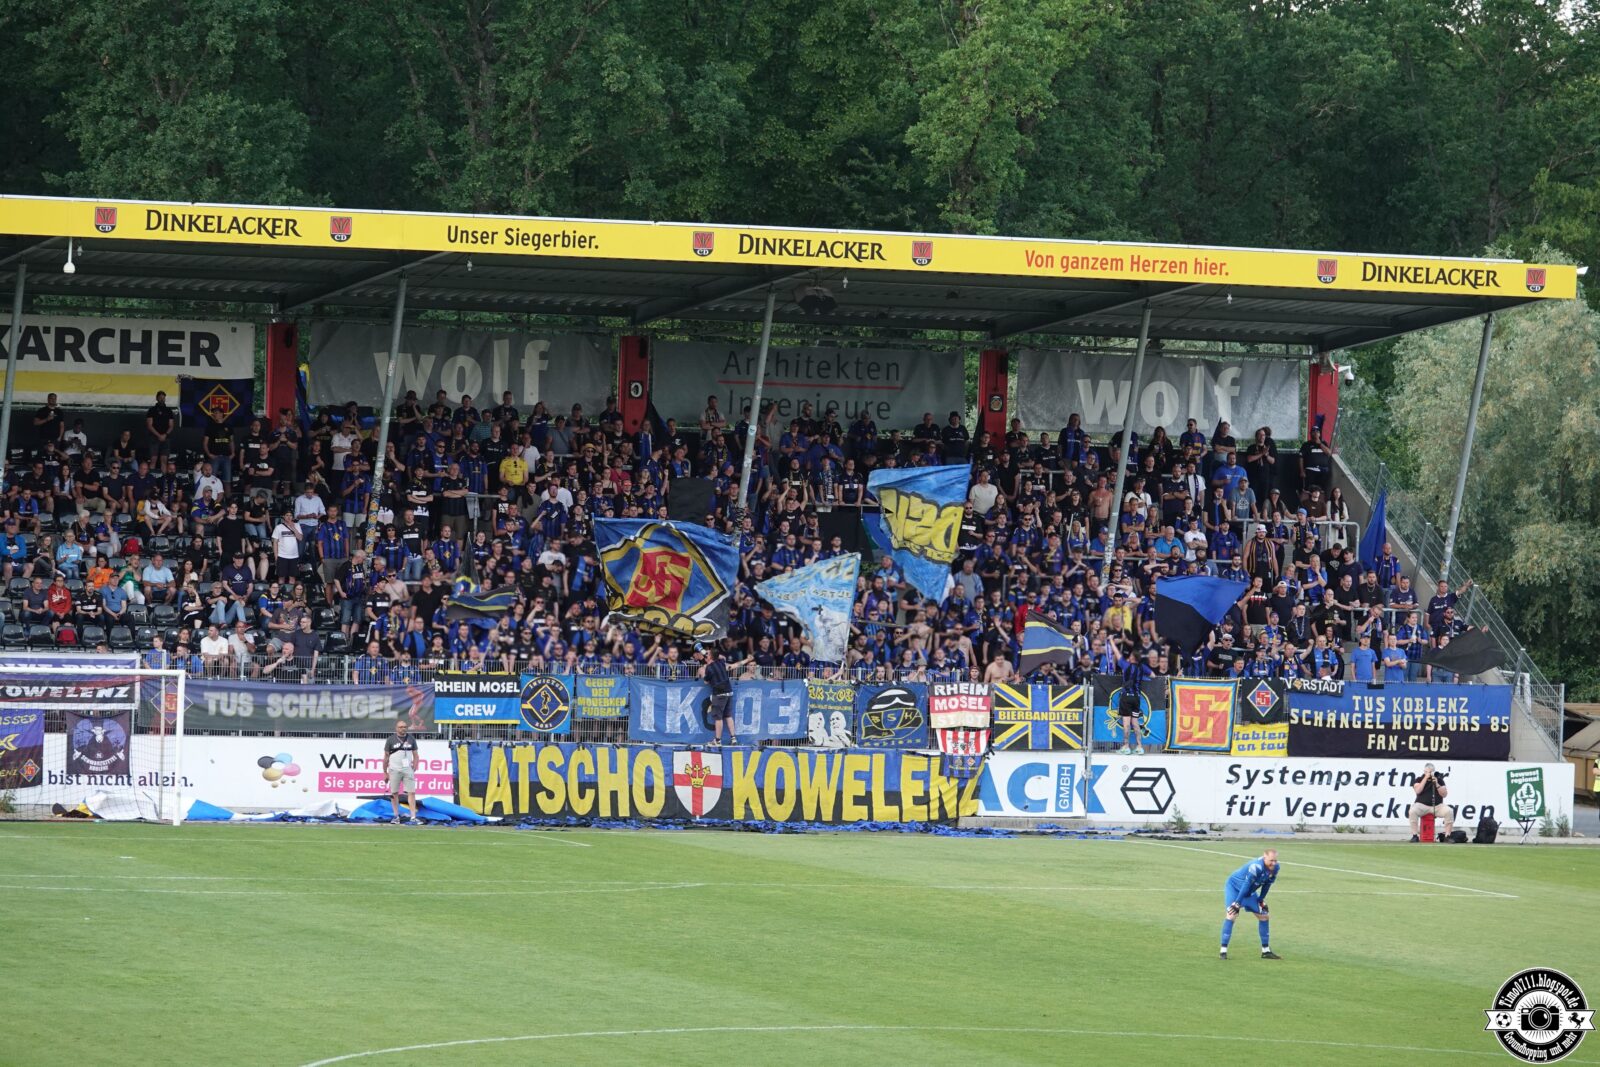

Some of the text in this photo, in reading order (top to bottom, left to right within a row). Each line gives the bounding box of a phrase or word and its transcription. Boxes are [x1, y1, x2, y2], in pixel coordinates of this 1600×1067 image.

[146, 208, 302, 239] DINKELACKER
[447, 225, 599, 251] Unser Siegerbier.
[738, 233, 887, 262] DINKELACKER
[1025, 249, 1230, 277] Von ganzem Herzen hier.
[1361, 260, 1501, 289] DINKELACKER
[373, 338, 551, 406] wolf
[722, 350, 900, 381] Arhitekten
[1076, 366, 1242, 431] wolf
[0, 685, 131, 698] OWELENZ
[435, 681, 520, 693] RHEIN MOSEL
[585, 678, 615, 687] GEGEN
[591, 687, 610, 697] DEN
[934, 682, 989, 696] RHEIN
[204, 691, 255, 717] TUS
[266, 690, 399, 719] SCHÄNGEL
[454, 704, 497, 716] CREW
[934, 695, 988, 711] MOSEL
[1352, 695, 1469, 713] TUS KOBLENZ
[998, 710, 1080, 722] BIERBANDITEN
[1289, 708, 1386, 730] SCHÄNGEL
[1392, 713, 1481, 732] HOTSPURS
[48, 770, 81, 786] bist
[324, 776, 347, 788] Sie
[428, 778, 455, 790] dru
[457, 744, 666, 818] LATSCHO
[1058, 765, 1072, 810] GMBH
[1510, 775, 1540, 785] regional
[1225, 794, 1271, 817] für
